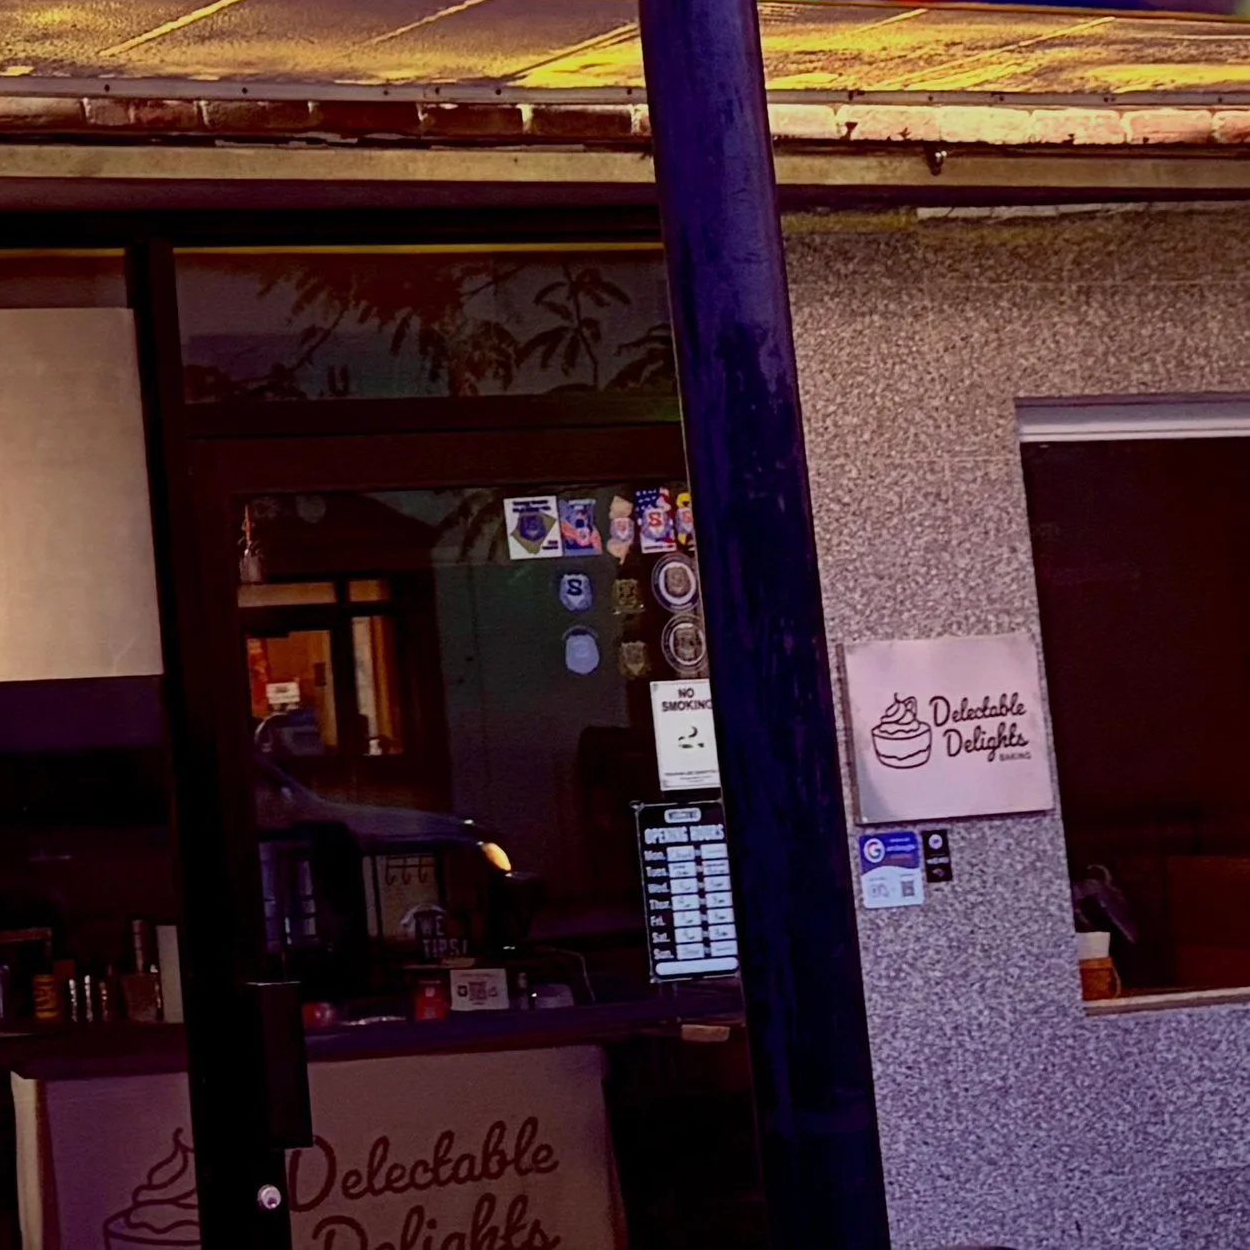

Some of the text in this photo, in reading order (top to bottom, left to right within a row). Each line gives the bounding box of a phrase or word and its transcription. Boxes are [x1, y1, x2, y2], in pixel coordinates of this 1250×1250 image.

[567, 578, 583, 596] S
[677, 687, 695, 699] NO
[929, 692, 1026, 727] Delectable
[943, 722, 1030, 762] Delights
[644, 823, 725, 844] OPENING HOURS
[287, 1116, 560, 1213] Delectable
